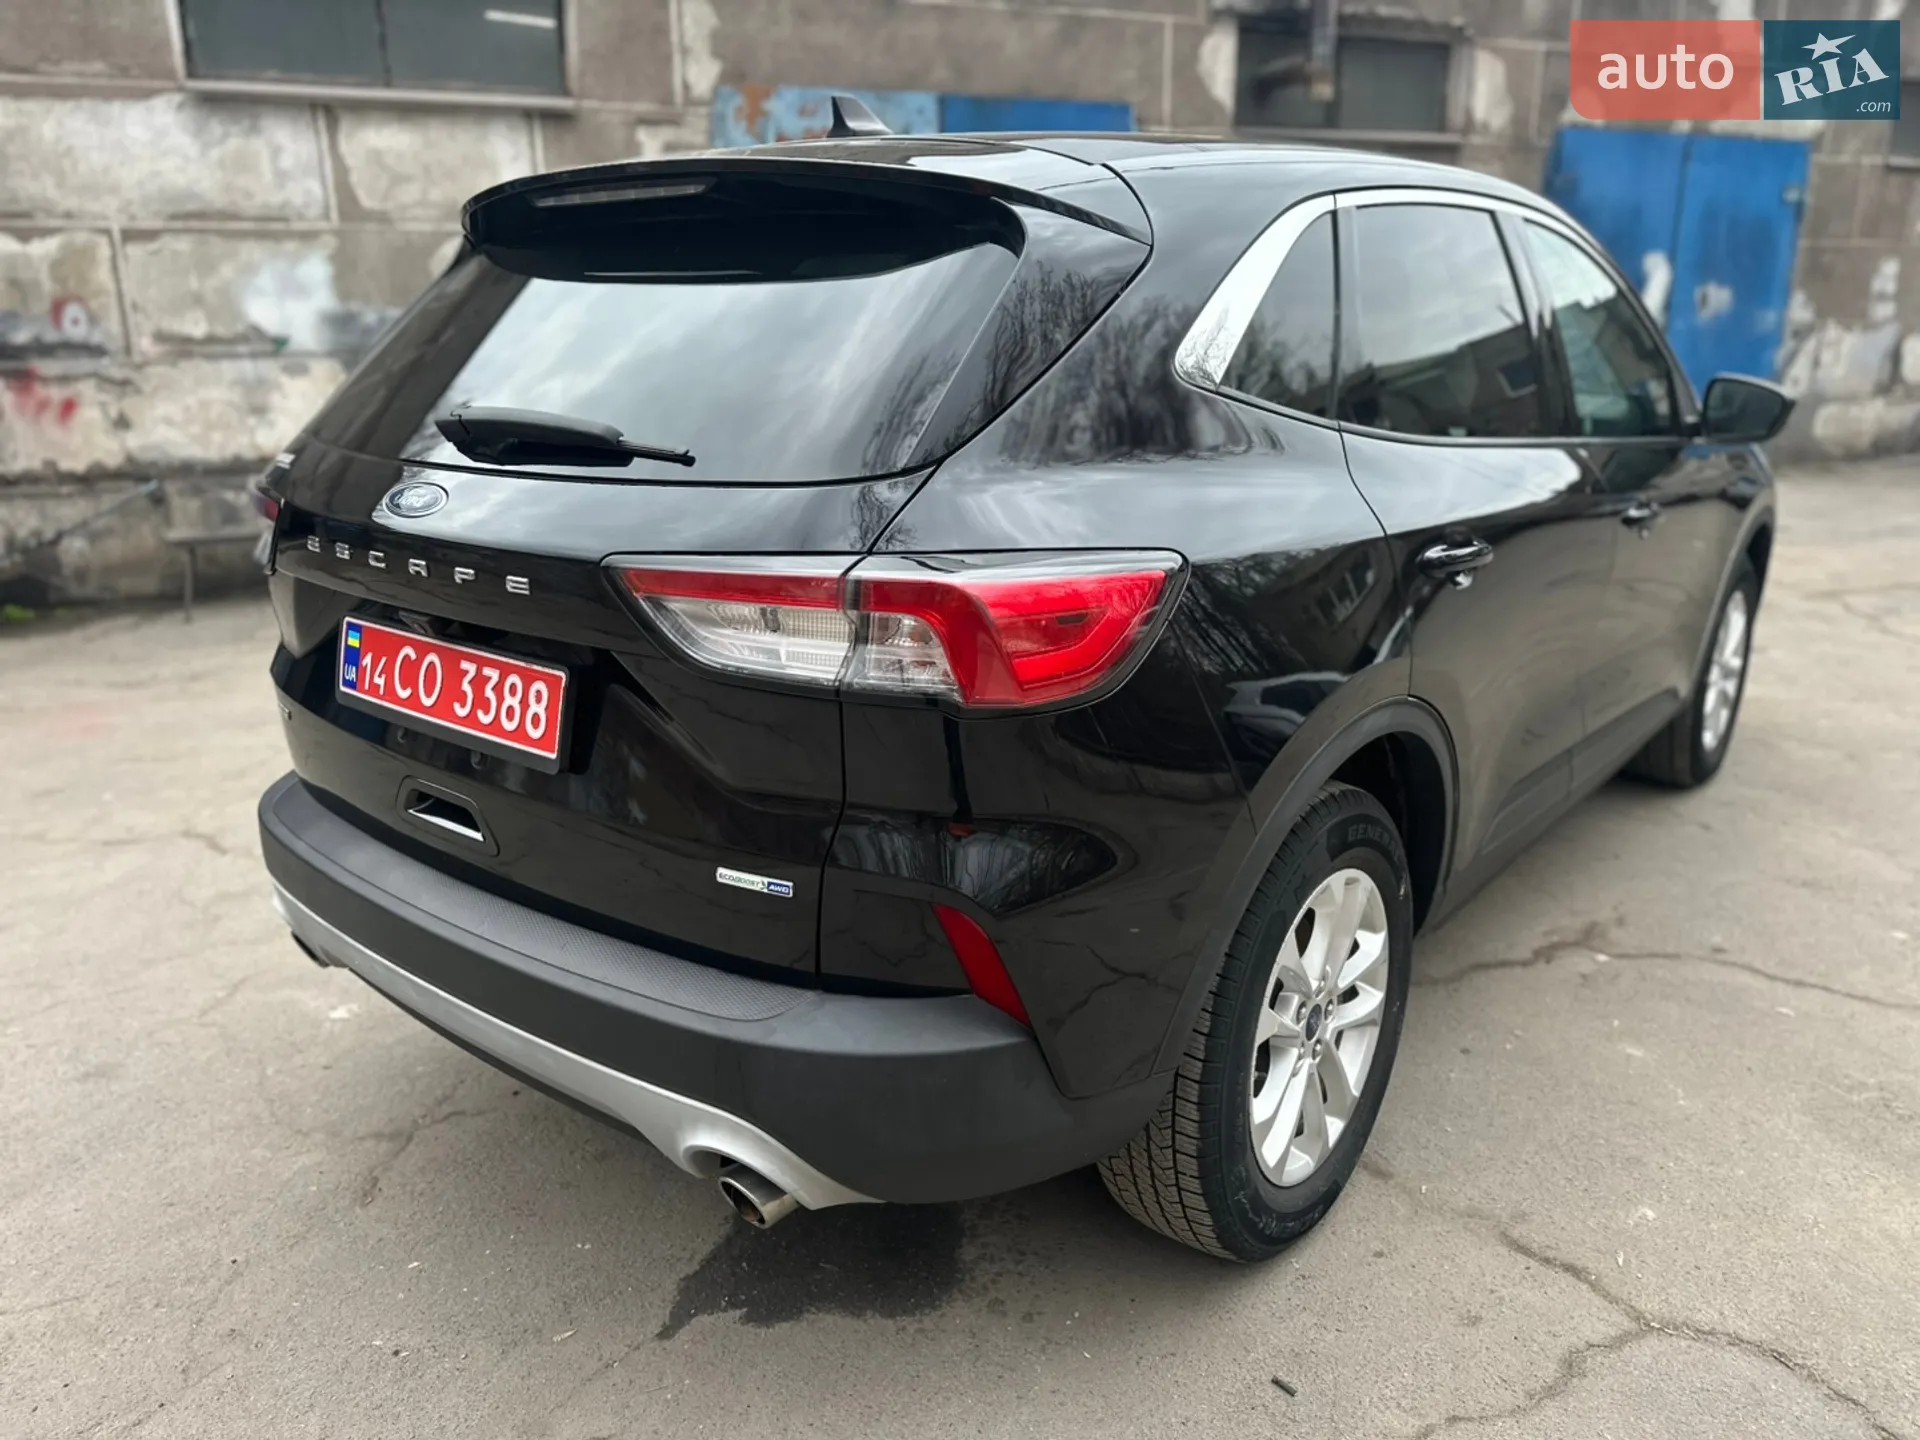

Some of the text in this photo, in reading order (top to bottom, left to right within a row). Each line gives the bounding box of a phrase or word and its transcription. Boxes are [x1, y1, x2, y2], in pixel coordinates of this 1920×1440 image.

[307, 535, 531, 595] ESCAPE
[344, 662, 357, 683] UA
[453, 659, 549, 740] 3388
[768, 884, 790, 894] AWD
